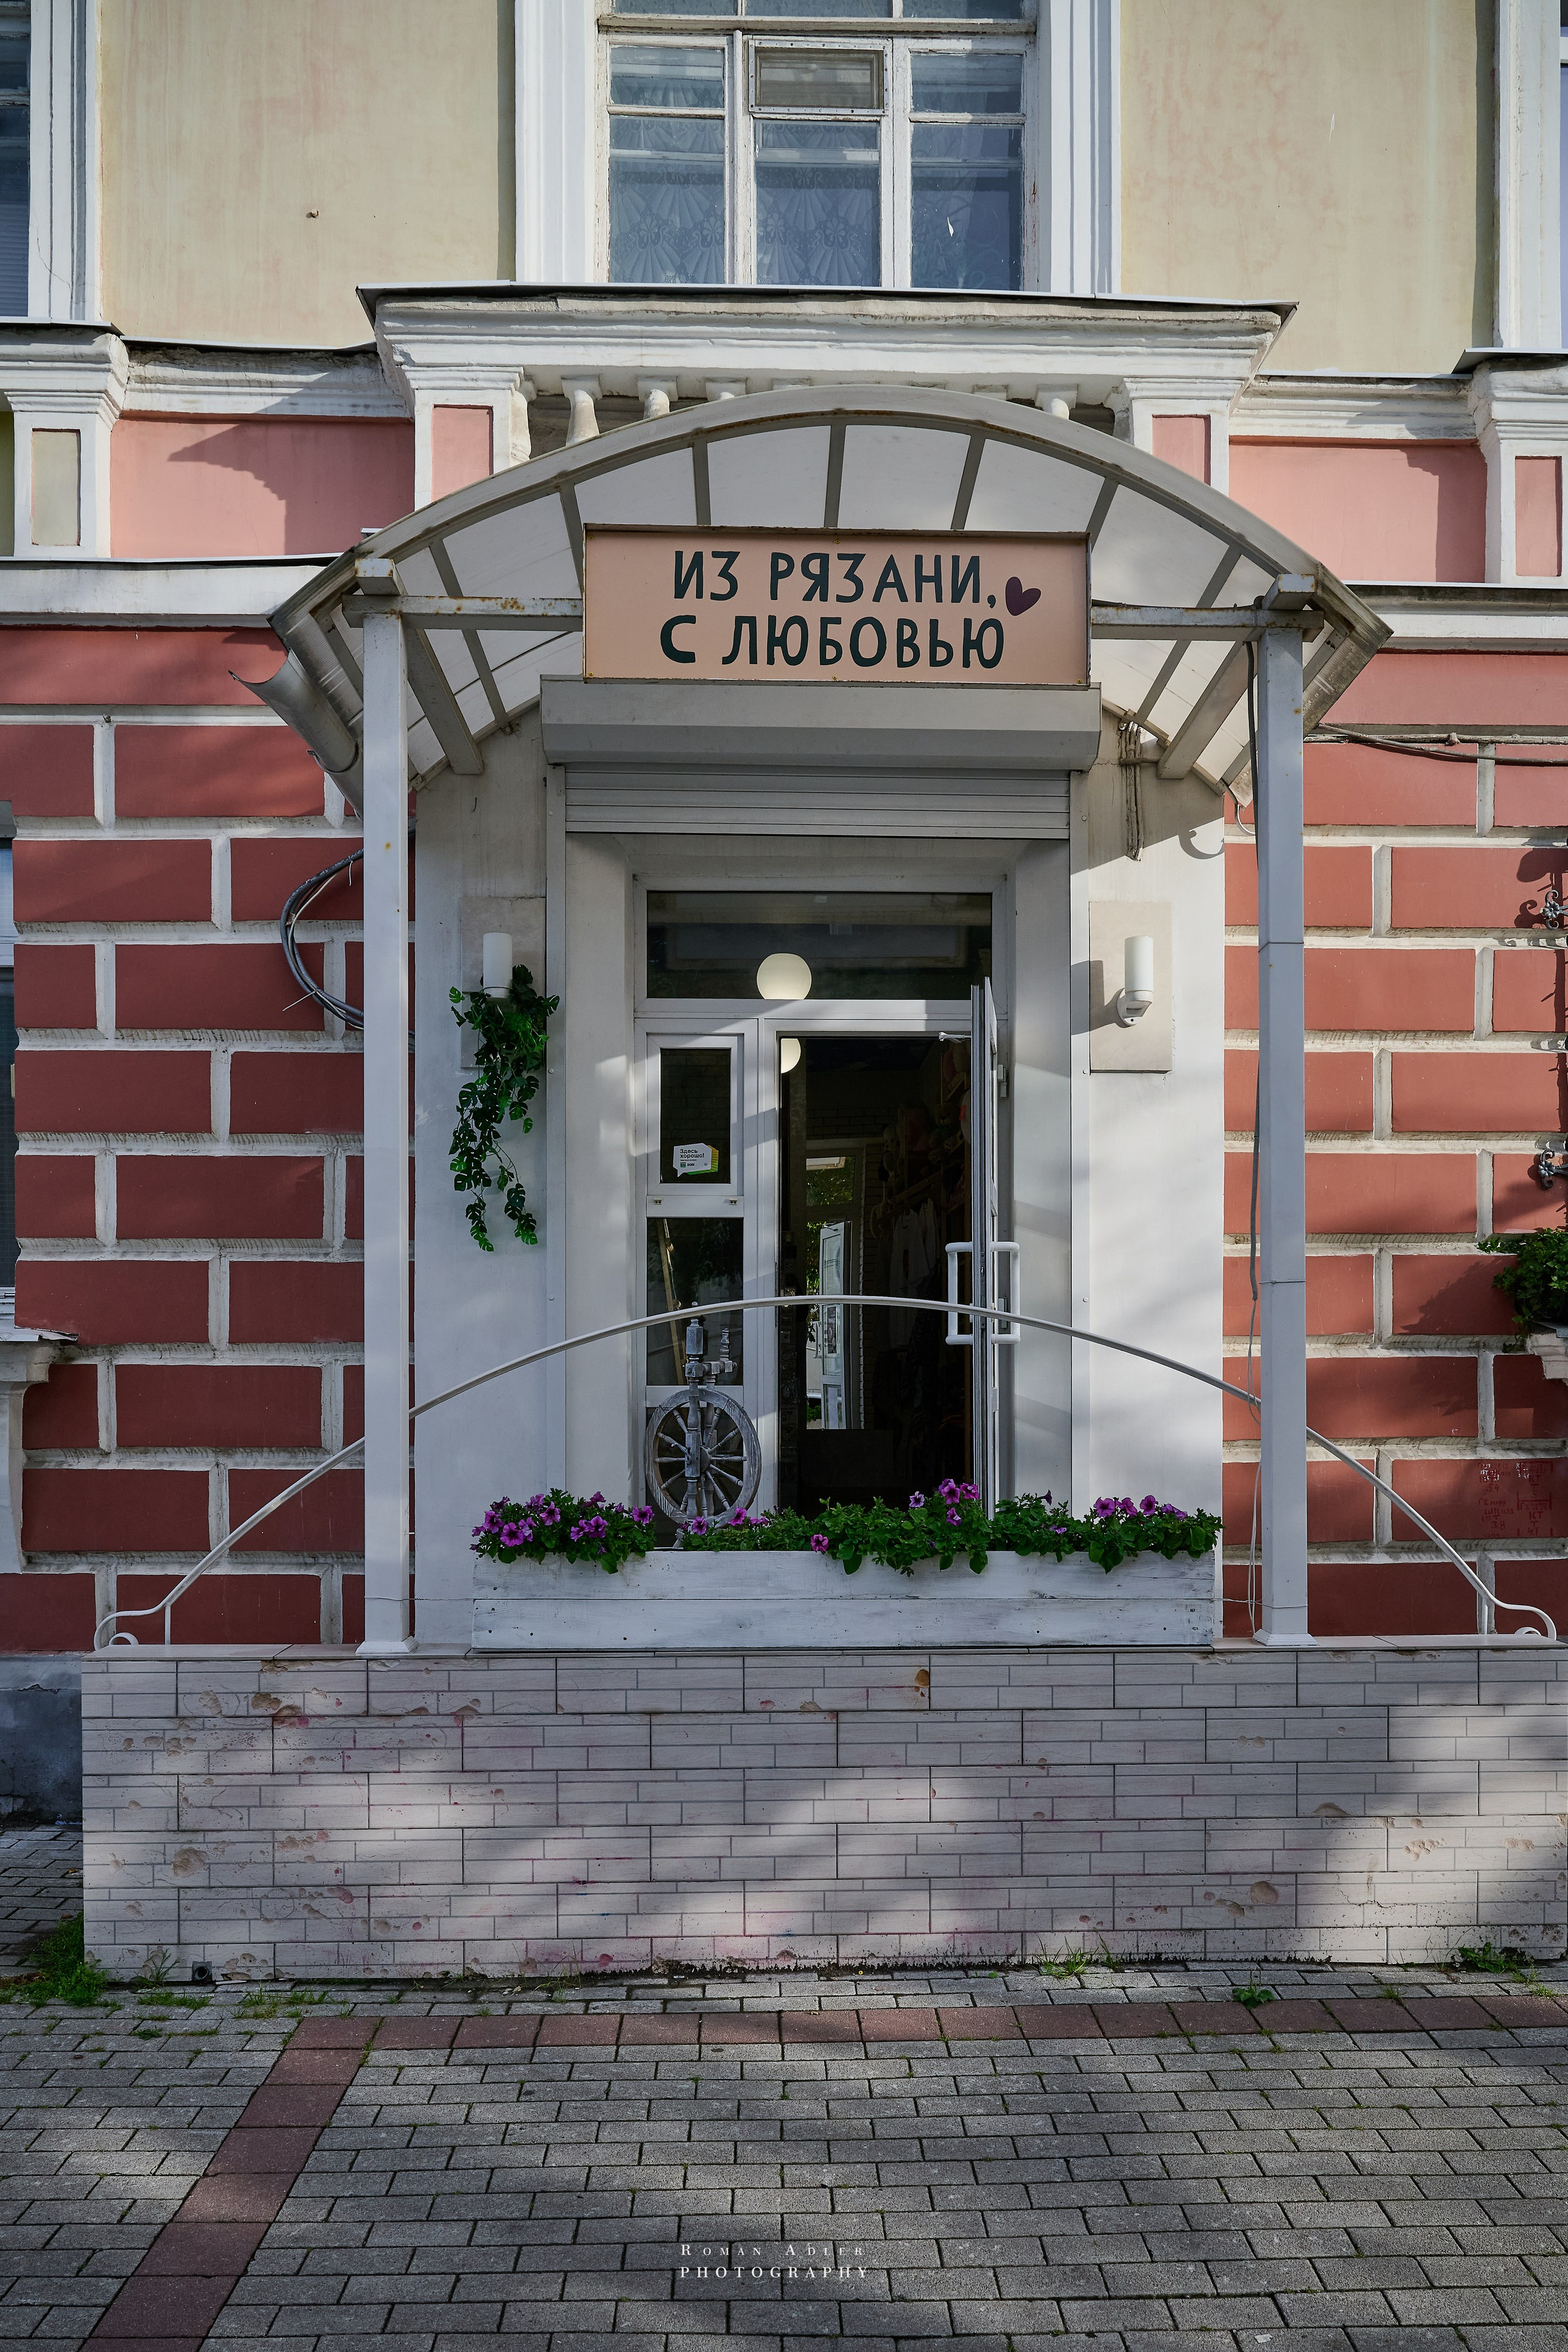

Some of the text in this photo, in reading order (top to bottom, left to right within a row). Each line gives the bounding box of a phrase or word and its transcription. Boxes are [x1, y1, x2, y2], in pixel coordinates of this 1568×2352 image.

[674, 550, 997, 609] ИЗ РЯЗАНИ,
[660, 614, 1005, 669] С ЛЮБОВЬЮ
